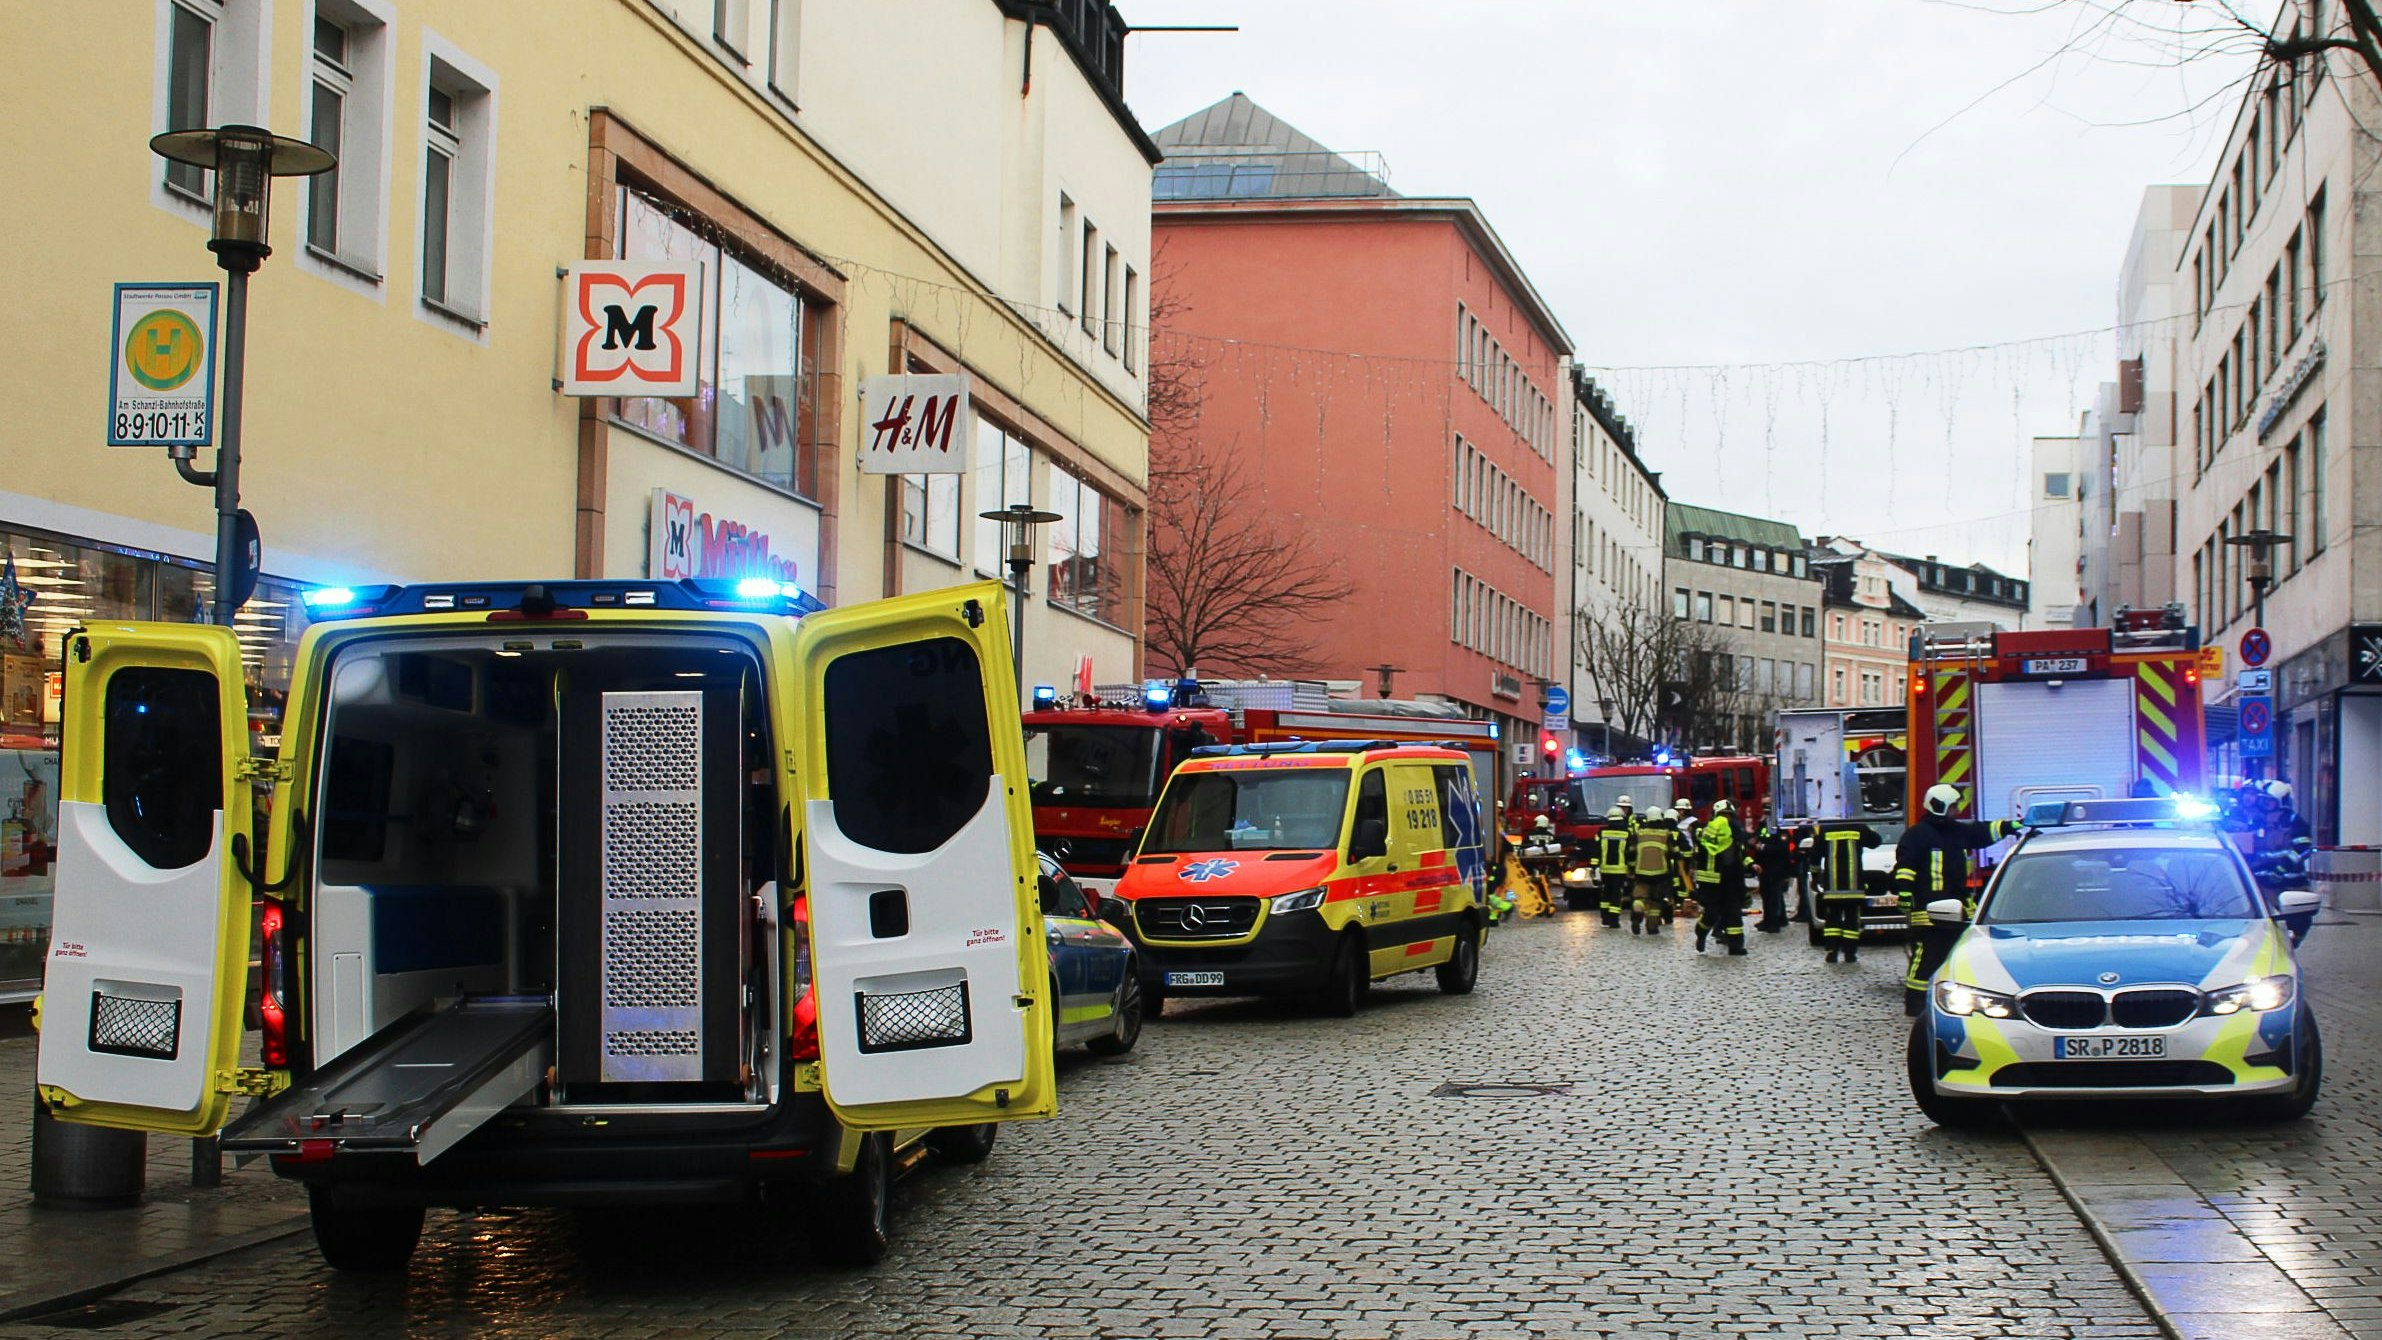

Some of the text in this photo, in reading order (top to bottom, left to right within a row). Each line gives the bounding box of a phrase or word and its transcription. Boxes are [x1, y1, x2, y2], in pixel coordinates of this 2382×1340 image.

[602, 304, 658, 351] M
[119, 400, 206, 410] Am Schanzl-Bahnhofstraße
[195, 412, 205, 425] K
[872, 394, 959, 454] H&M
[194, 426, 204, 439] 4
[670, 520, 685, 558] M
[2058, 659, 2079, 671] 237
[2241, 737, 2270, 750] TAXI
[1407, 808, 1438, 830] 19 218
[967, 938, 981, 947] ganz
[1170, 973, 1223, 985] FRG DD 99
[2066, 1037, 2164, 1056] SR P 2818
